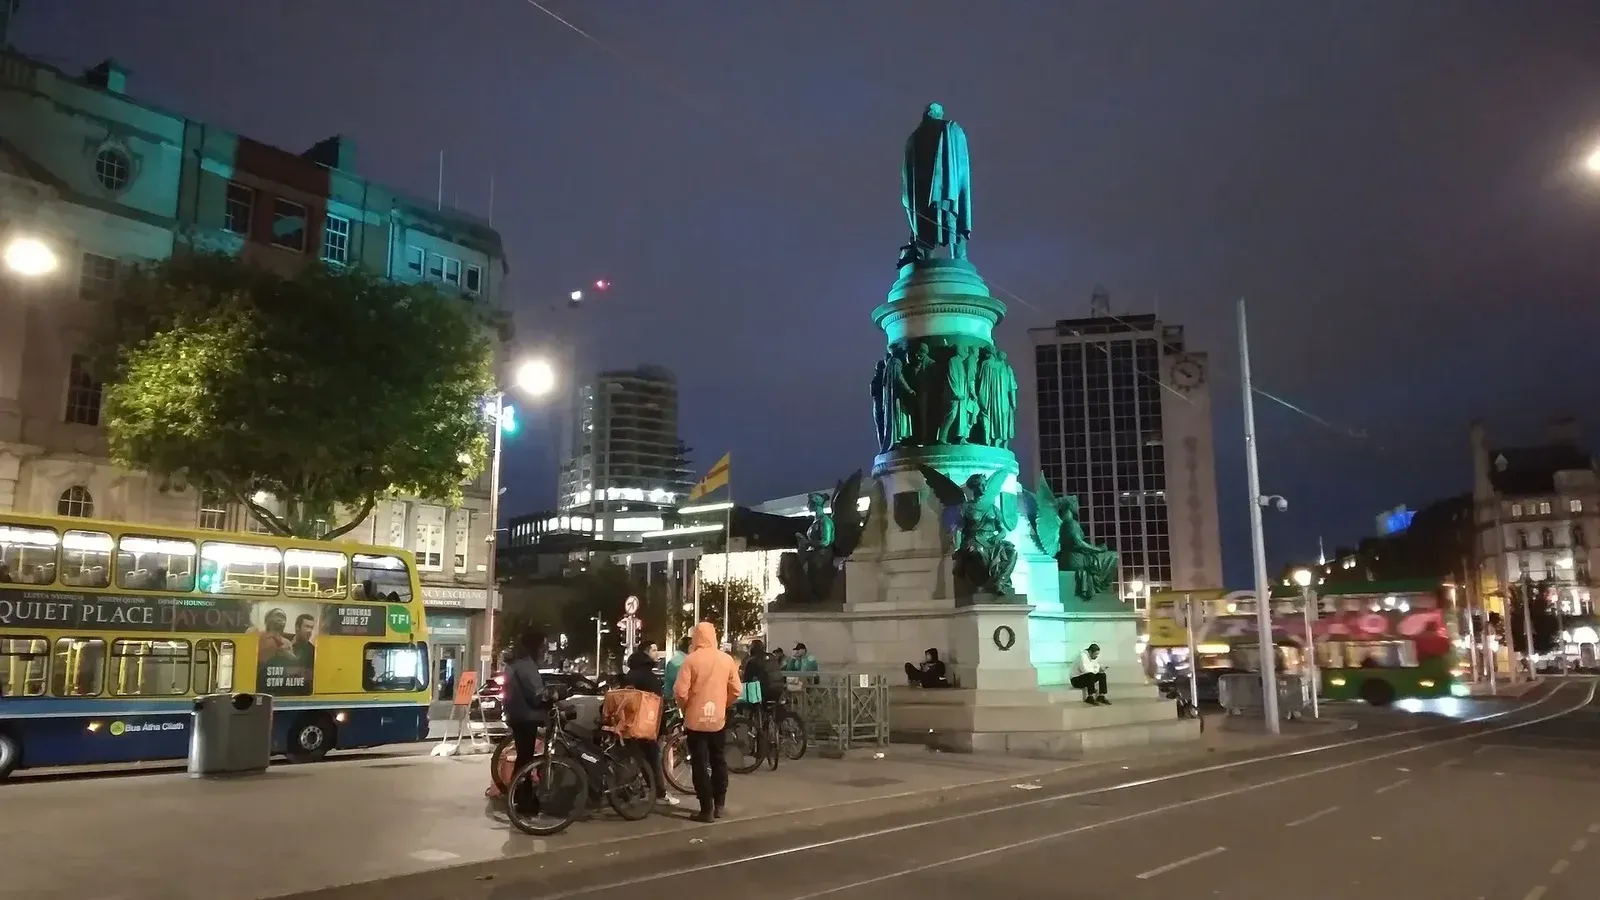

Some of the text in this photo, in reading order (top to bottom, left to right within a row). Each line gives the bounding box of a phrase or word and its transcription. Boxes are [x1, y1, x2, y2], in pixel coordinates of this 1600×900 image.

[422, 590, 487, 599] NCY EXCHANG
[0, 600, 74, 623] QUIET
[82, 604, 153, 624] PLACE
[160, 606, 199, 626] DAY
[339, 608, 372, 617] IN CINEMAS
[341, 616, 369, 626] JUNE 27
[390, 614, 409, 625] TFI
[266, 667, 284, 676] STAY
[266, 677, 305, 687] STAY ALIVE
[125, 724, 141, 732] Bus
[162, 722, 184, 731] Cliath
